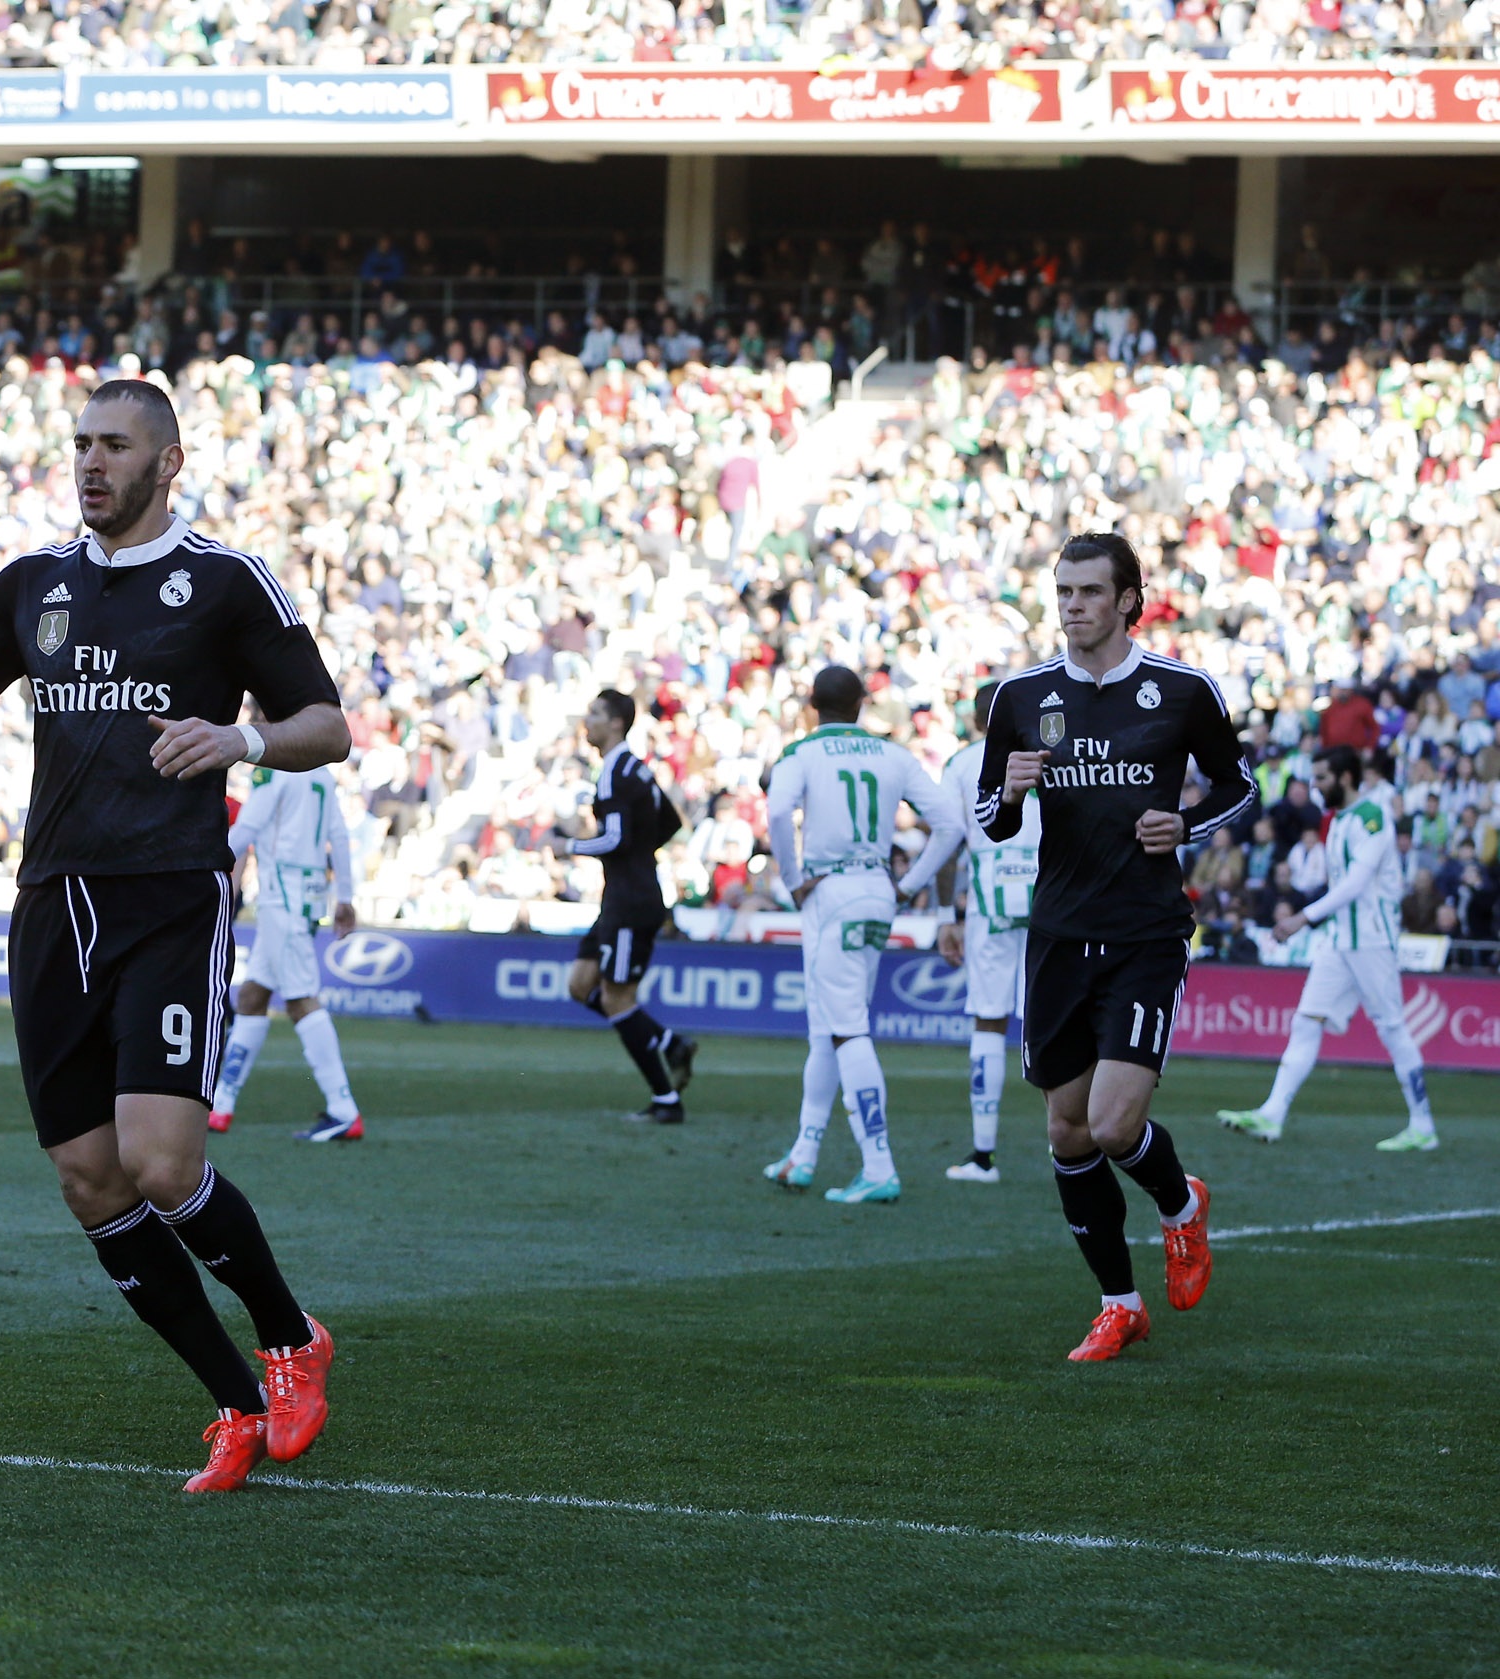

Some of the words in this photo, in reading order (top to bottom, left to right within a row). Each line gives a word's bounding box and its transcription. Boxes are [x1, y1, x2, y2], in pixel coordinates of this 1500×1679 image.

[42, 594, 73, 604] adidas
[74, 645, 118, 675] Fly
[32, 673, 172, 713] Emirates
[823, 738, 885, 756] EDIMAR
[1073, 738, 1110, 760] Fly
[1042, 758, 1155, 788] Emirates
[837, 769, 879, 843] 11
[162, 1003, 192, 1065] 9
[1129, 1001, 1165, 1054] 11
